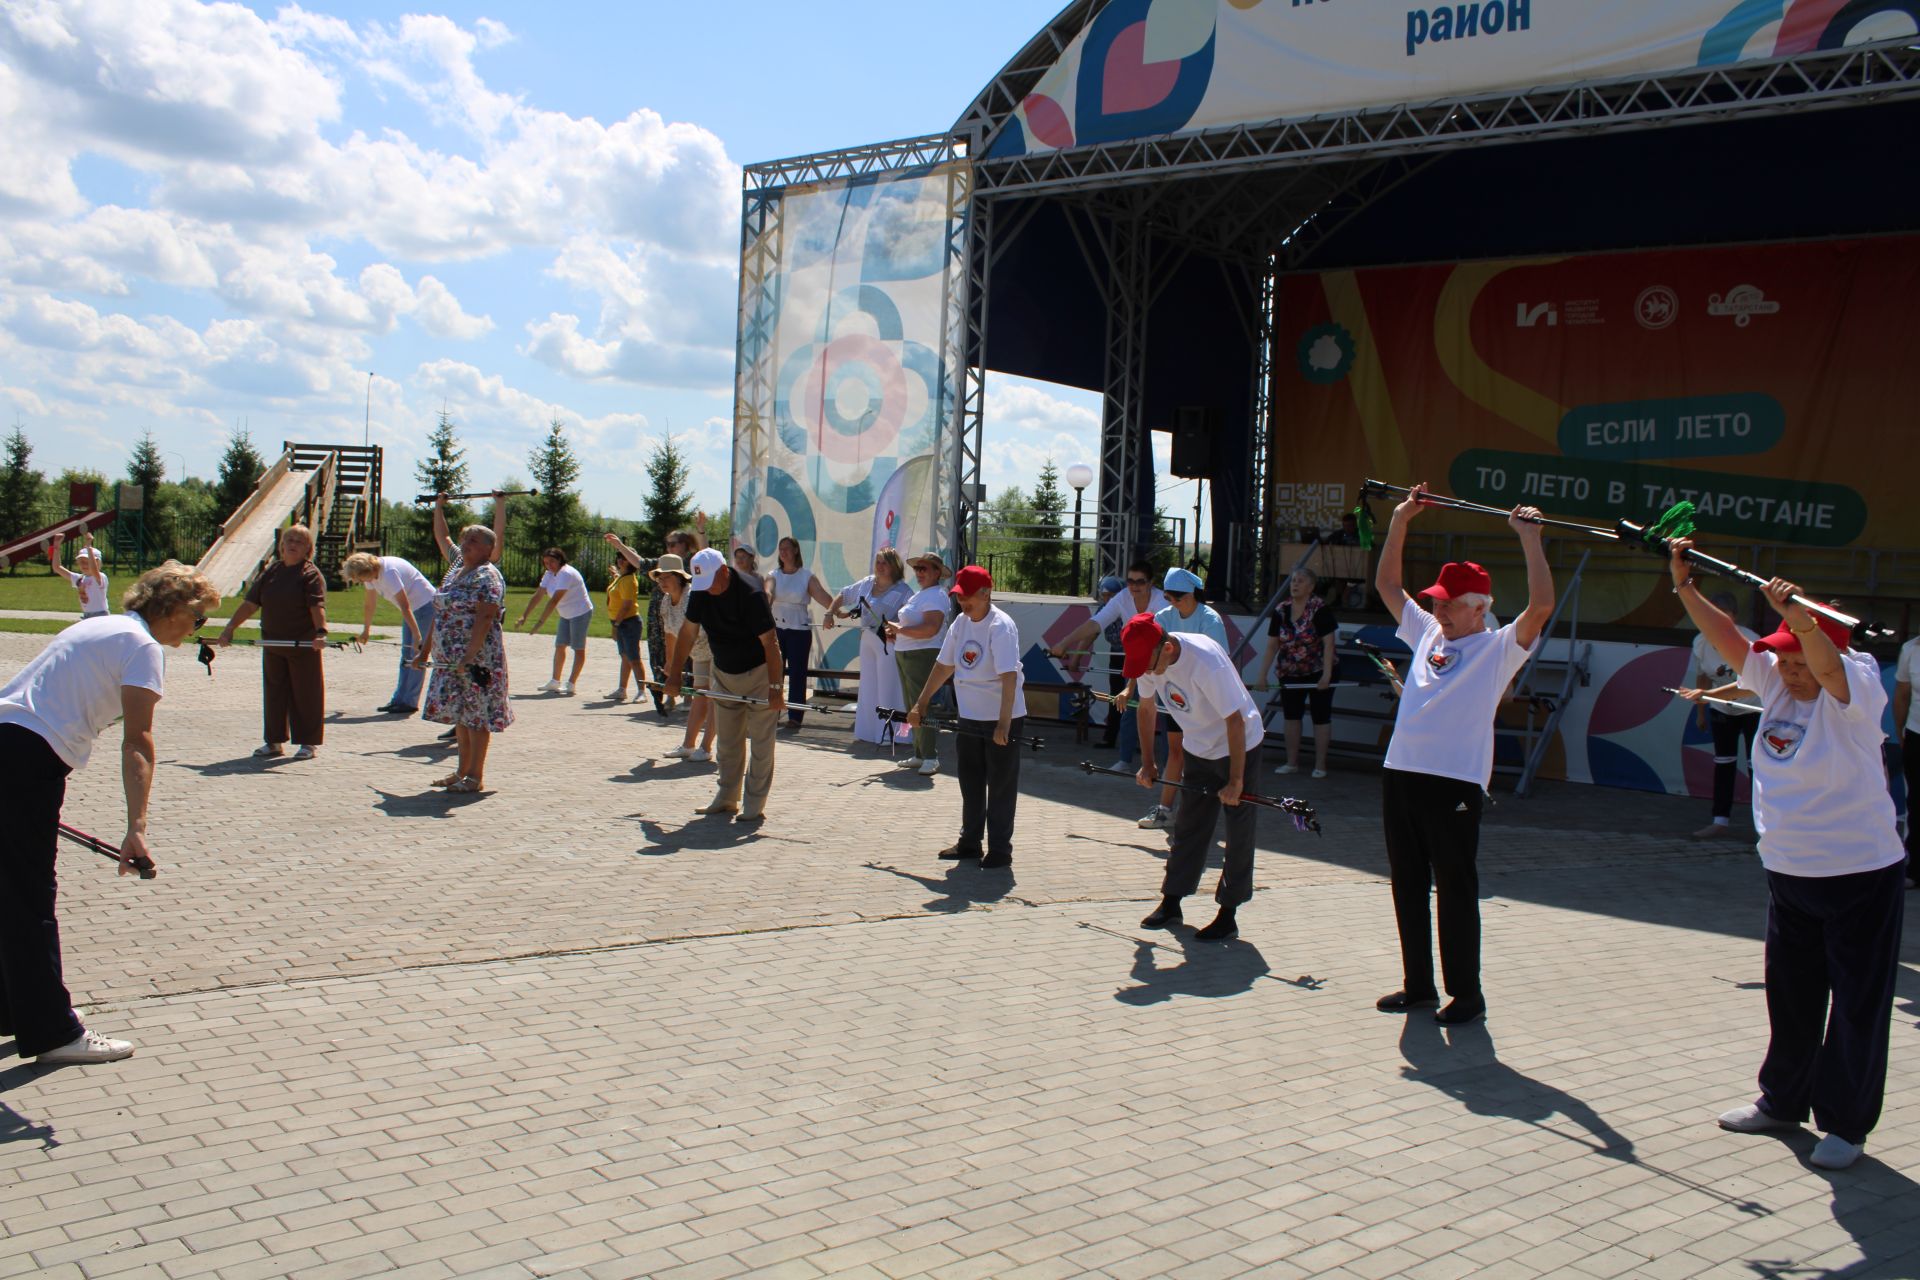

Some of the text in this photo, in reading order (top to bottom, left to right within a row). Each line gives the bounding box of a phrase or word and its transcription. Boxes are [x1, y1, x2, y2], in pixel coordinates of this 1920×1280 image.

[1586, 412, 1752, 446] ЕСЛИ ЛЕТО
[1475, 467, 1835, 530] ТО ЛЕТО В ТАТАРСТАНЕ
